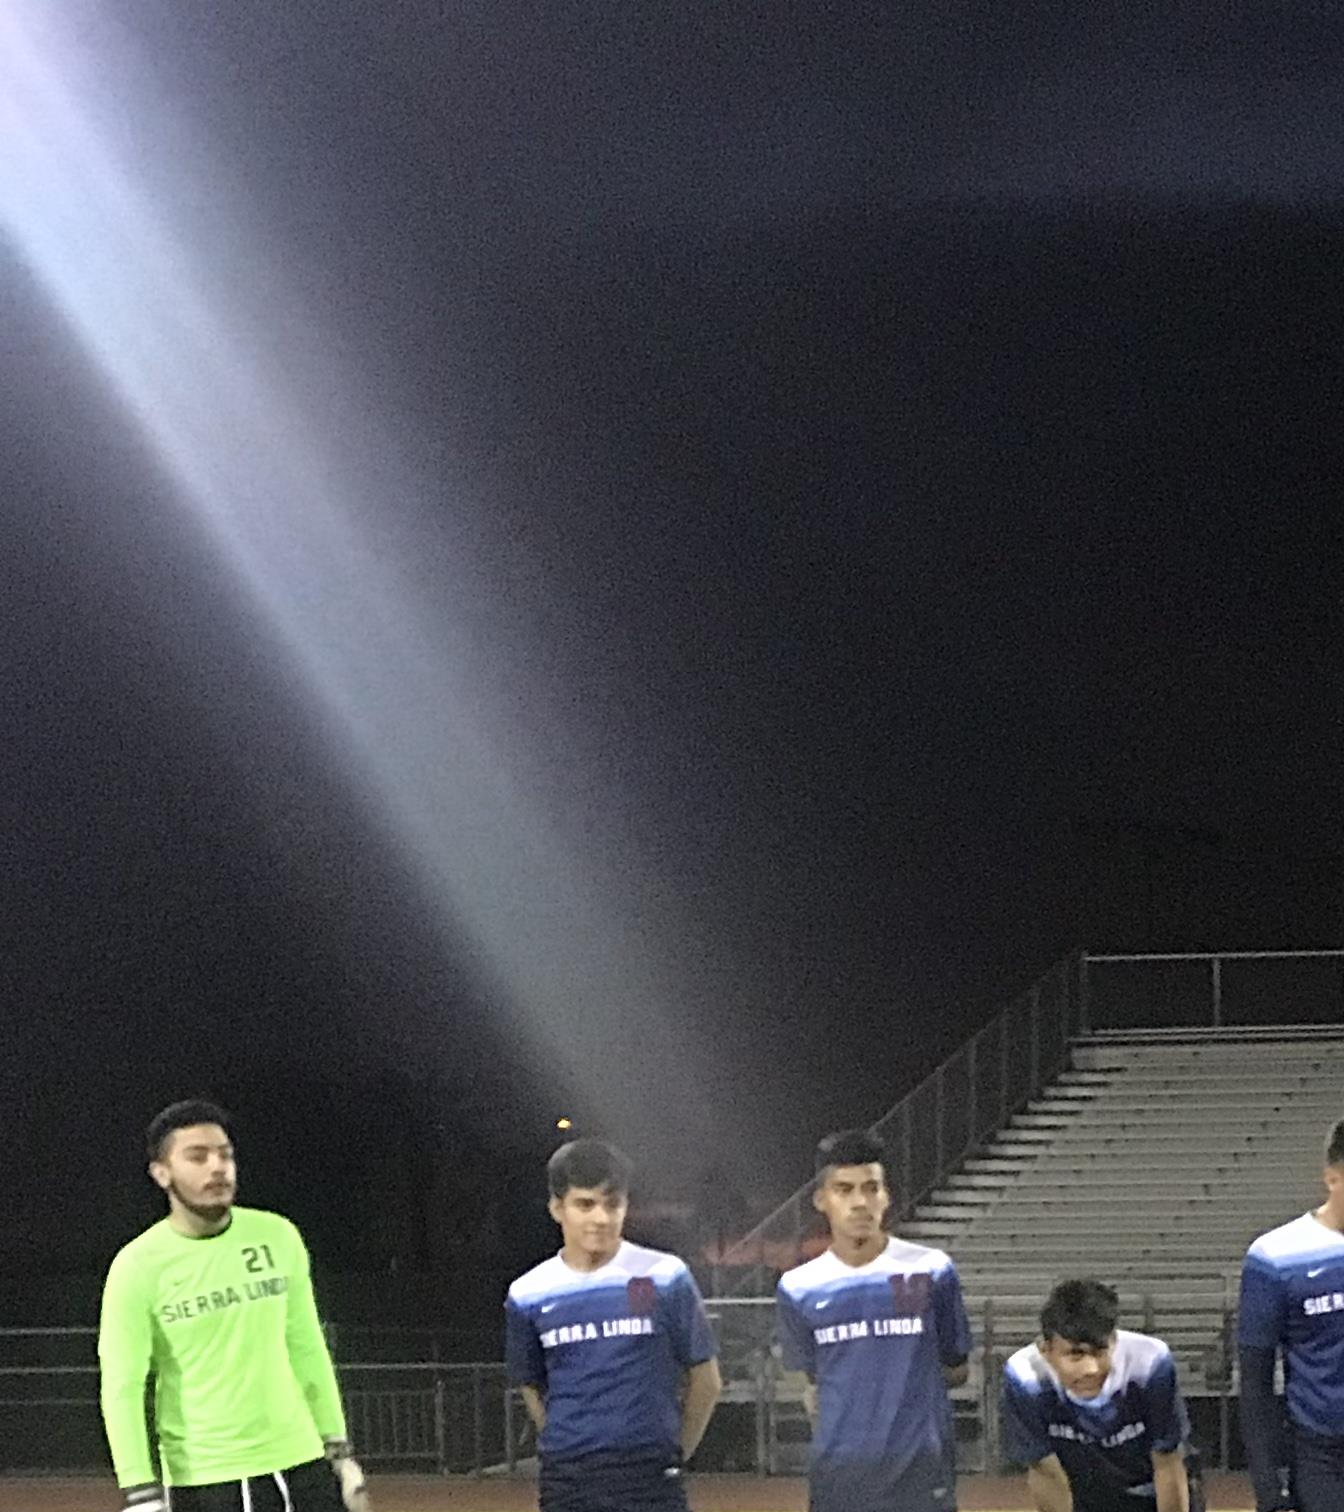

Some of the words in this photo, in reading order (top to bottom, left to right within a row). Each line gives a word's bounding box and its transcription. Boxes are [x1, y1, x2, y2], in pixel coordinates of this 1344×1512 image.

[241, 1244, 275, 1273] 21
[160, 1287, 241, 1323] SIERRA
[602, 1318, 653, 1337] LINDA
[874, 1316, 923, 1336] LINDA
